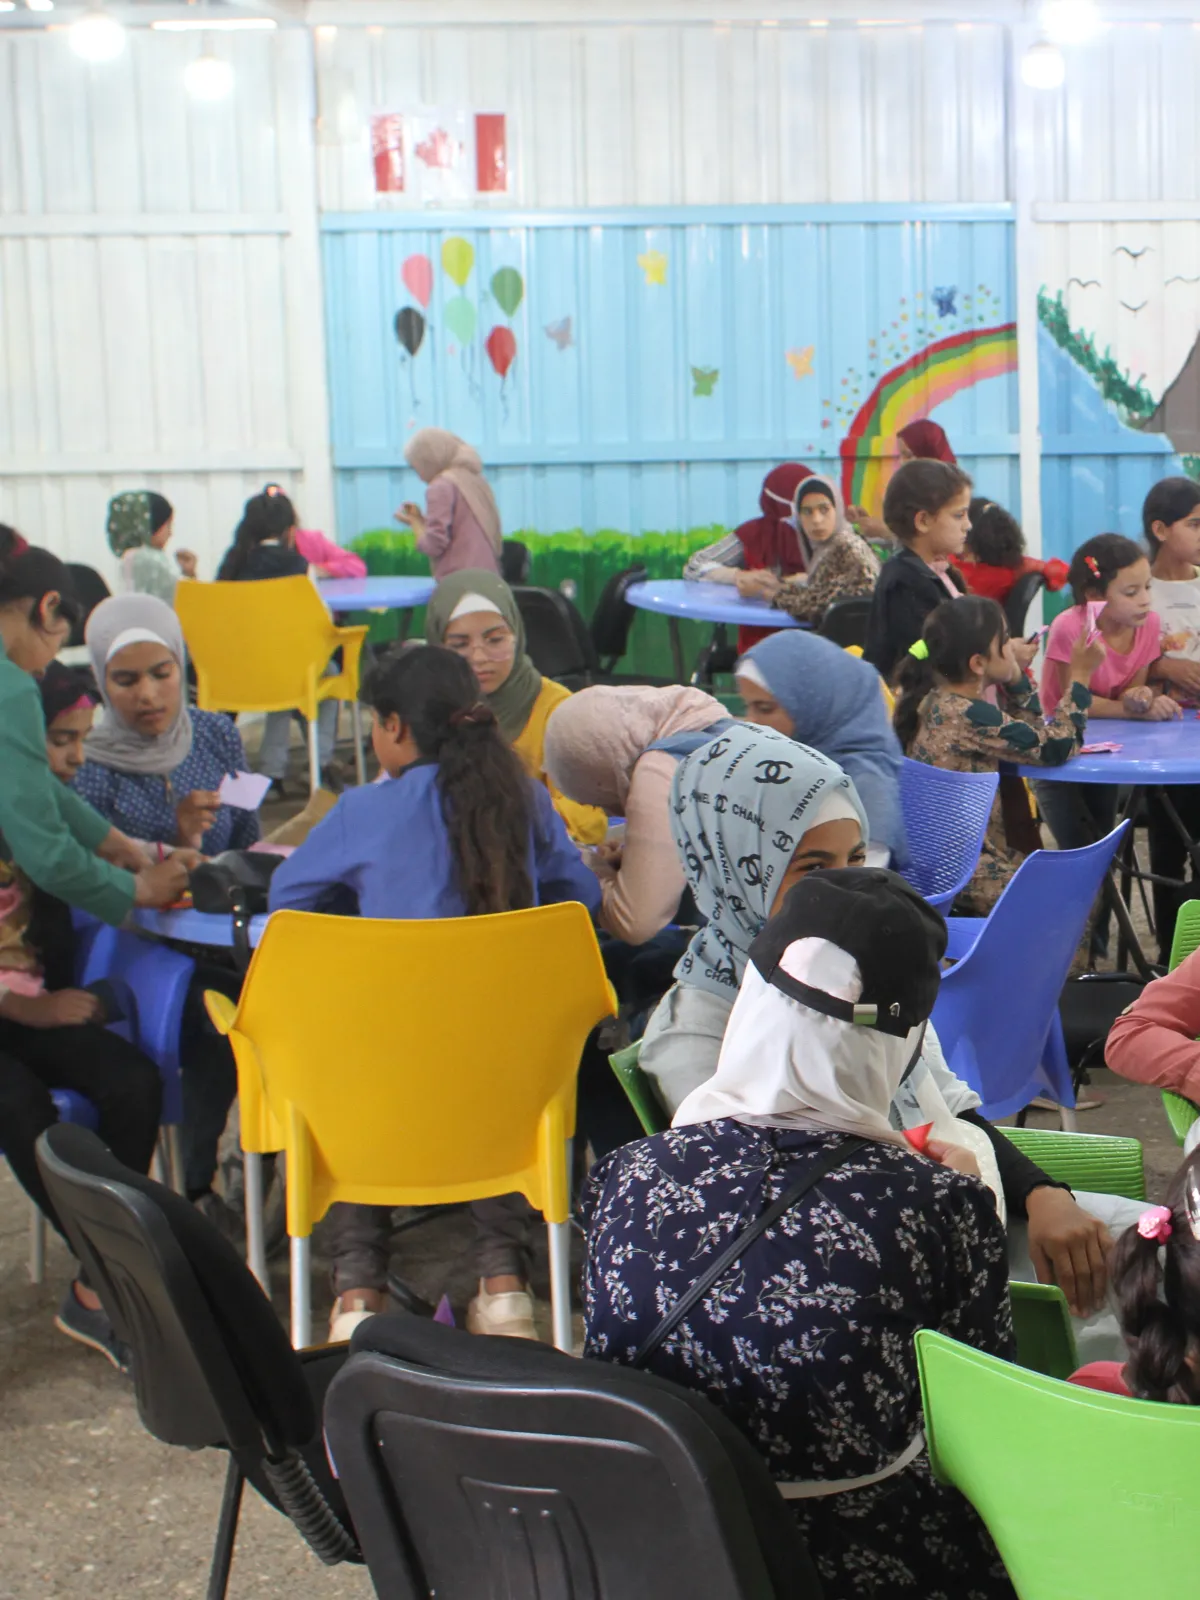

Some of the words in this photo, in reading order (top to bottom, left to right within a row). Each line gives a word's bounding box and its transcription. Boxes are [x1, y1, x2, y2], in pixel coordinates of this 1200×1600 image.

[723, 743, 757, 781] CHANEL
[789, 778, 826, 821] CHANEL
[715, 831, 732, 884] CHANEL
